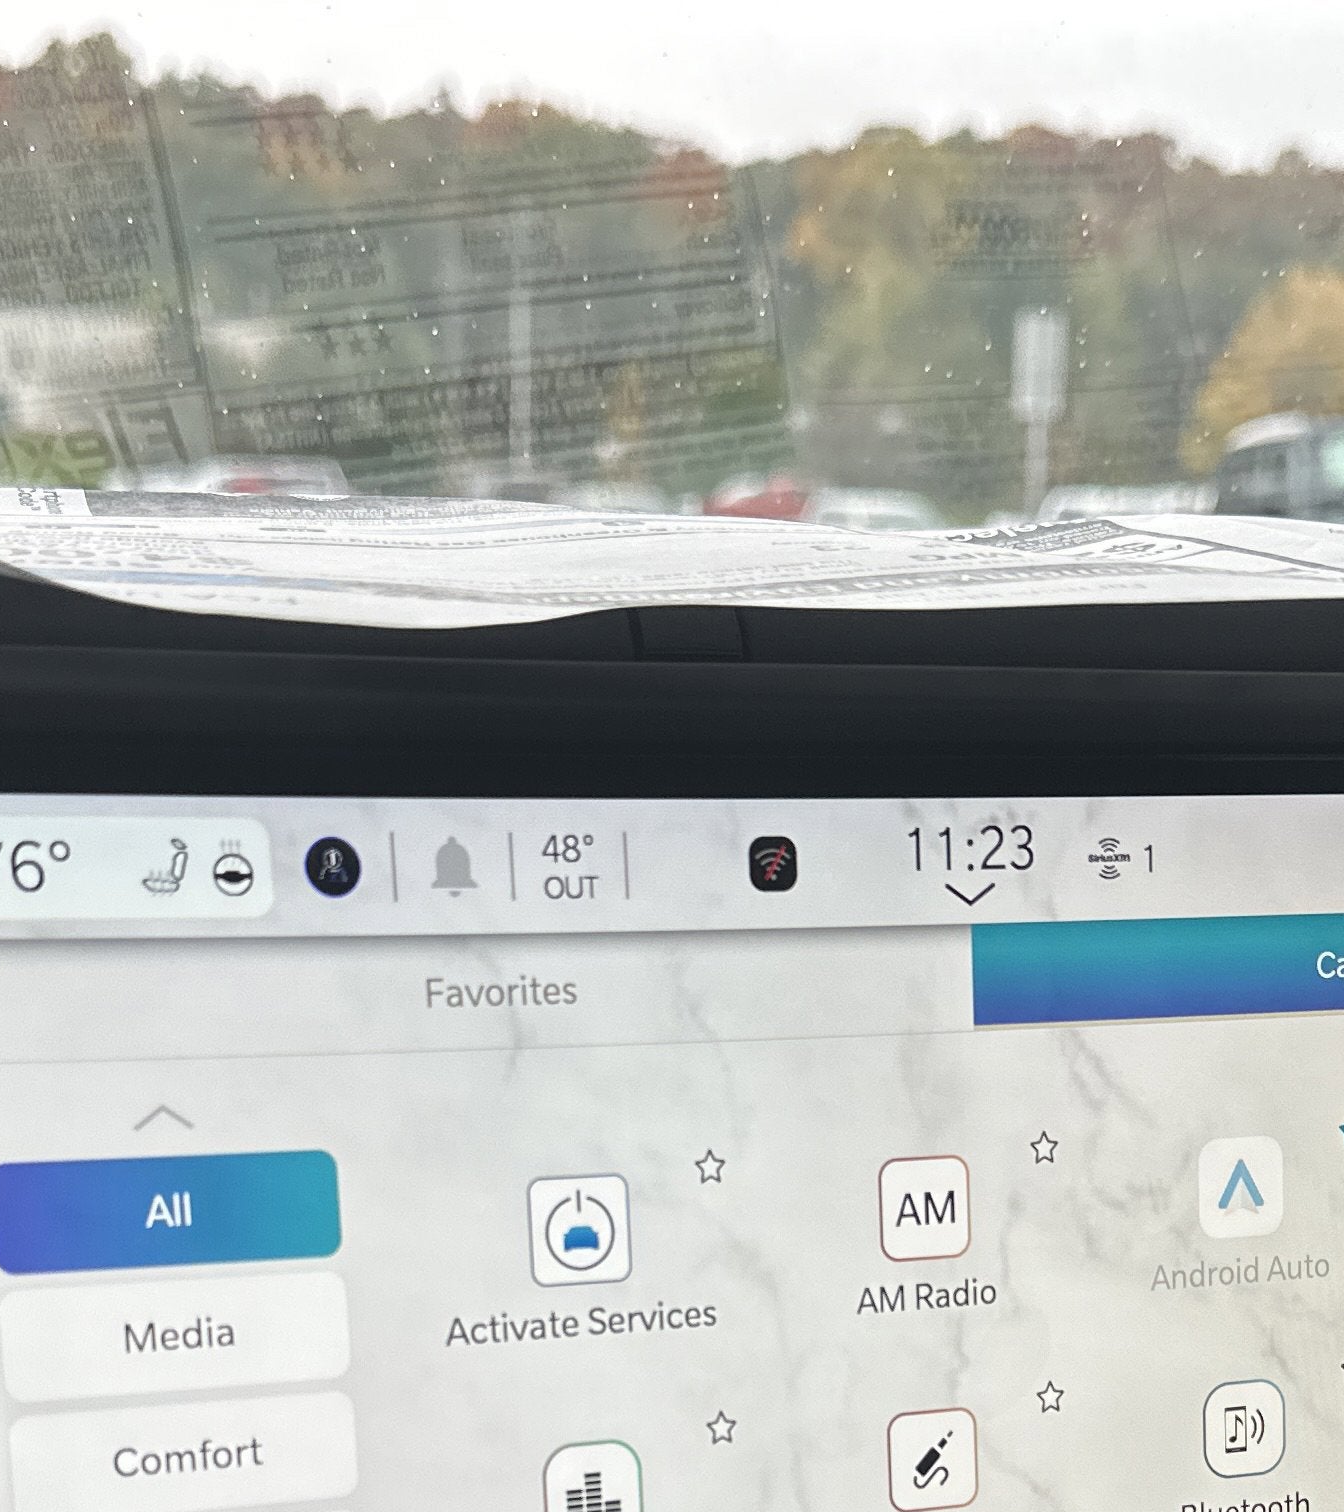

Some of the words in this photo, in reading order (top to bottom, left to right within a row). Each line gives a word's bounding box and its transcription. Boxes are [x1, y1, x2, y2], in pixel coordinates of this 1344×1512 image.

[905, 824, 1036, 875] 11:23
[543, 873, 599, 902] OUT
[425, 974, 579, 1010] Favorites
[145, 1193, 193, 1229] All
[893, 1190, 958, 1229] AM
[1149, 1257, 1260, 1294] Android
[1266, 1251, 1332, 1285] Auto
[855, 1284, 909, 1316] AM
[916, 1276, 999, 1312] Radio
[122, 1317, 237, 1355] Media
[444, 1310, 580, 1349] Activate
[587, 1299, 719, 1342] Services
[111, 1436, 265, 1480] Comfort
